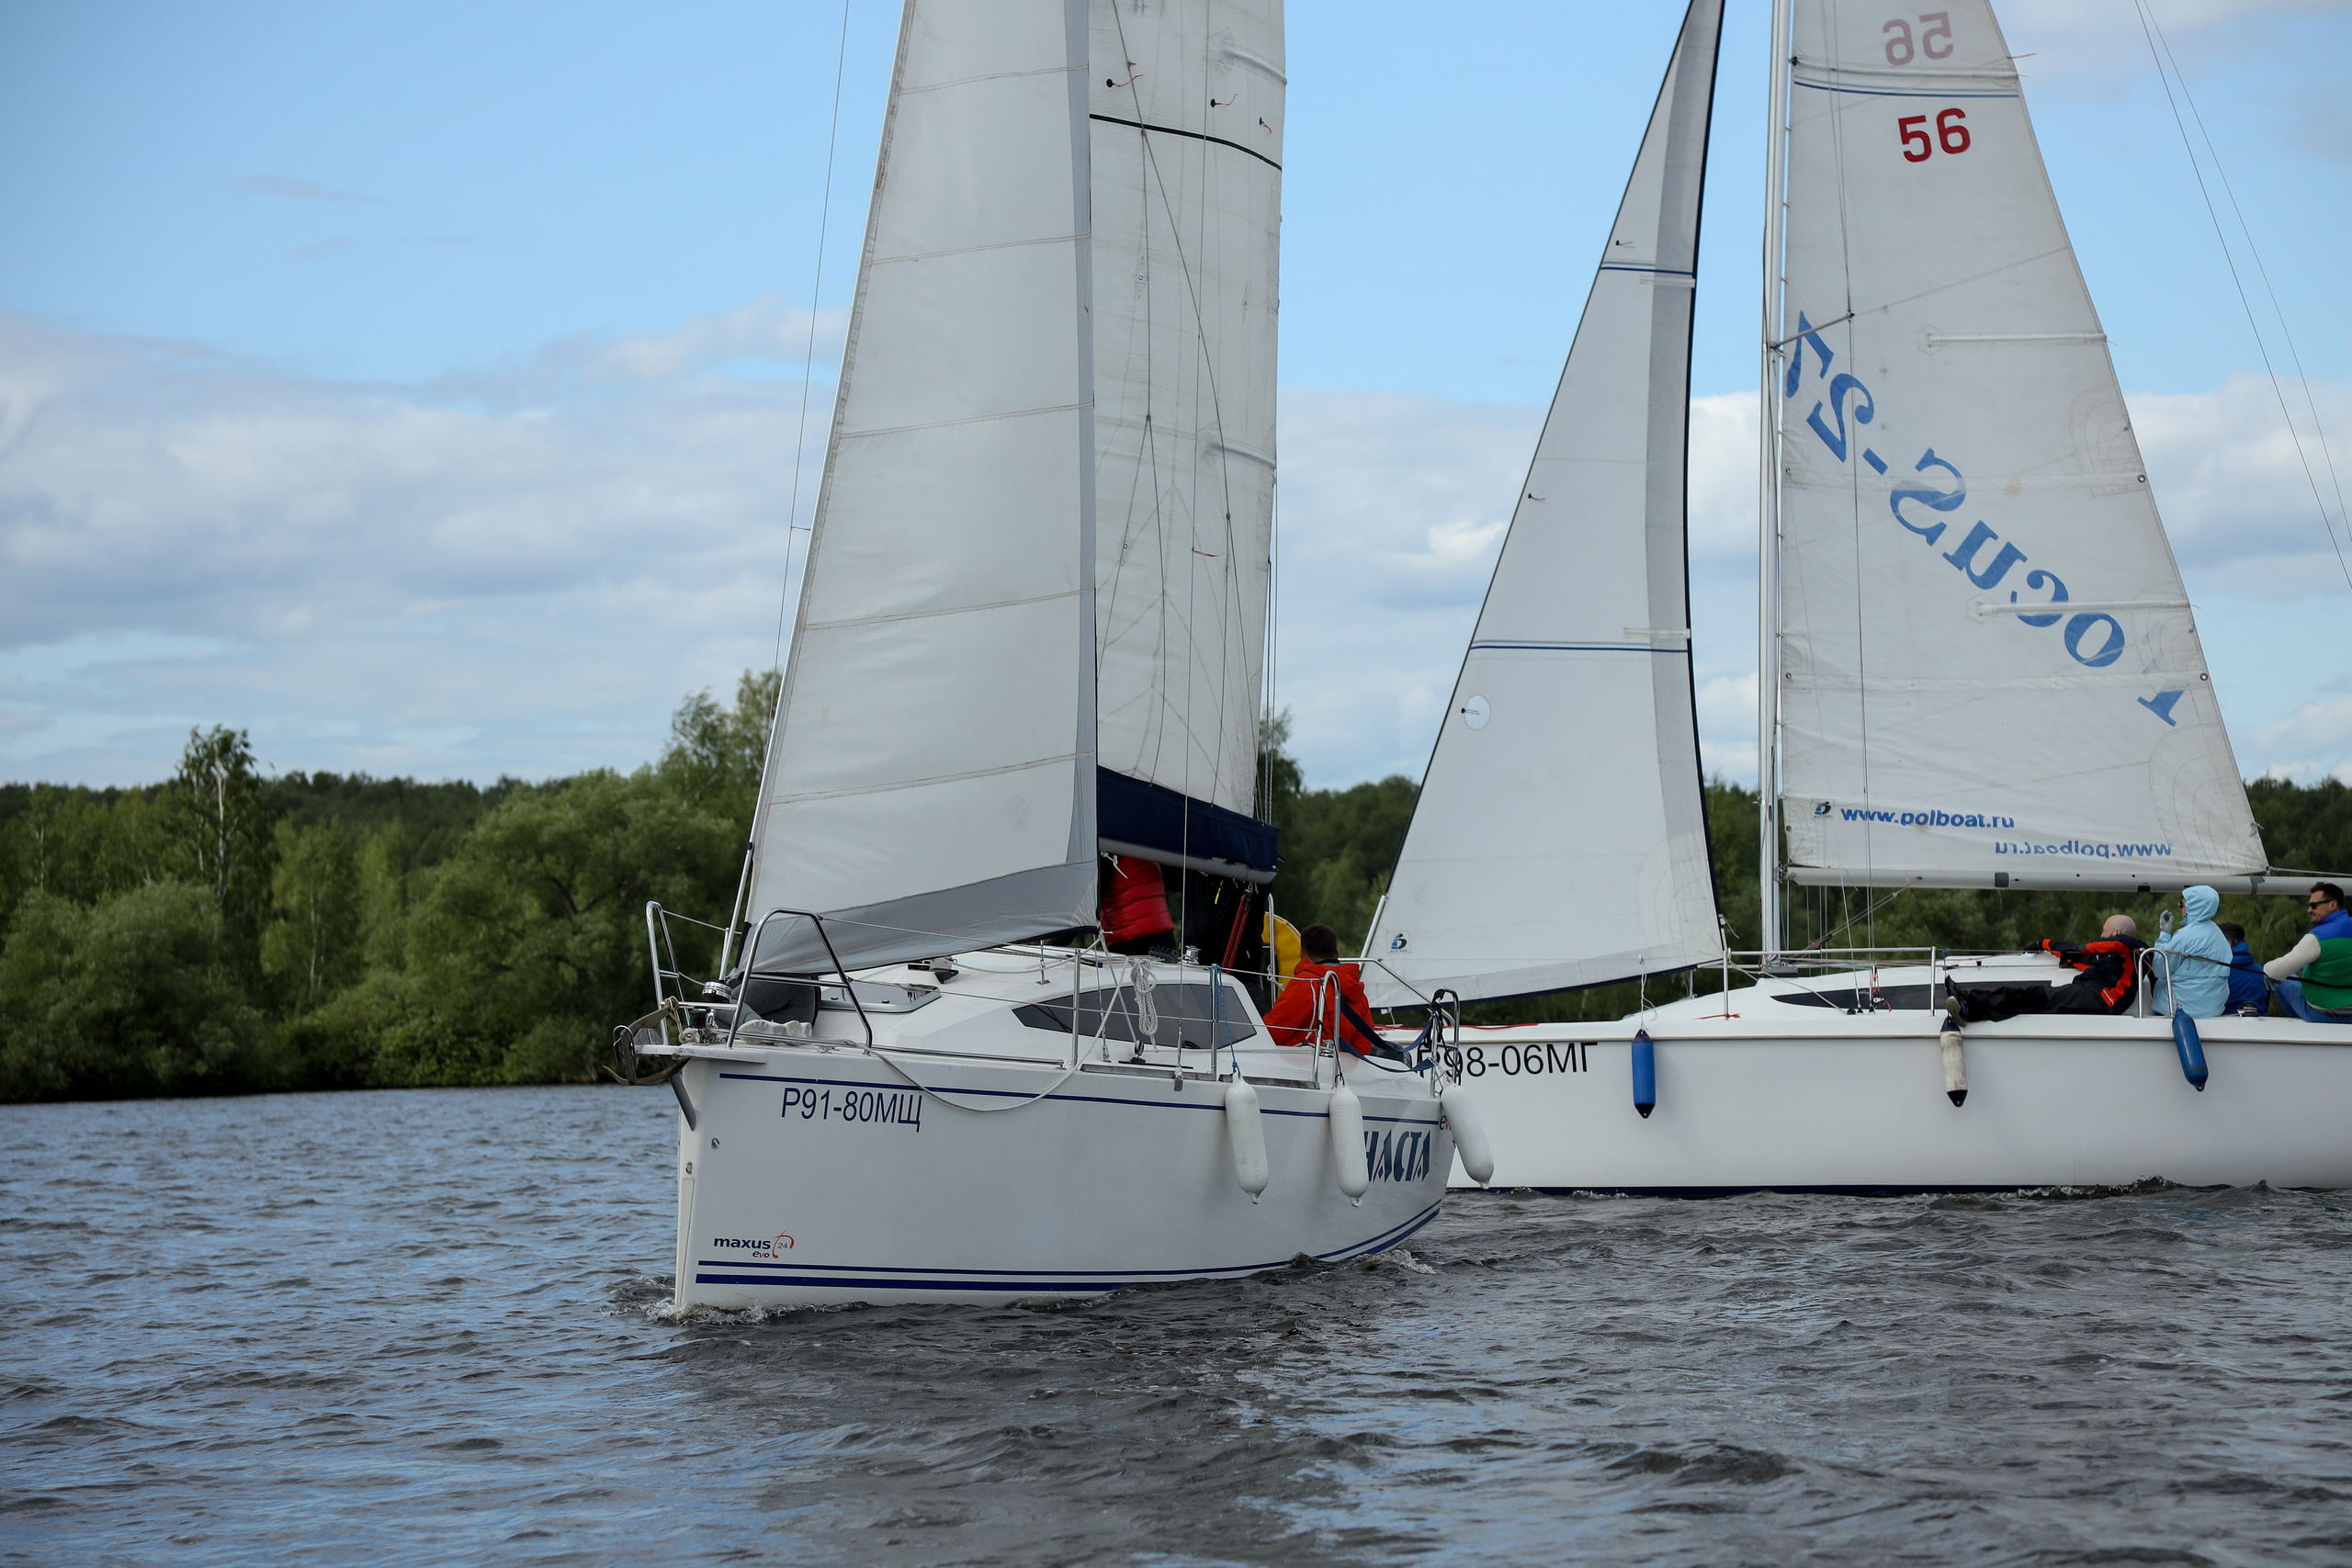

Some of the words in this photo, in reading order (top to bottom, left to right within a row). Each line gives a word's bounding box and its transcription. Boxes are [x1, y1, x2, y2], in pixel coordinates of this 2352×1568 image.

[1897, 107, 1971, 163] 56
[1840, 807, 2015, 829] www.polboat.ru
[782, 1088, 922, 1133] Р91-80МЩ
[1439, 1114, 1453, 1131] ev
[714, 1237, 771, 1250] maxus
[752, 1250, 770, 1258] evo
